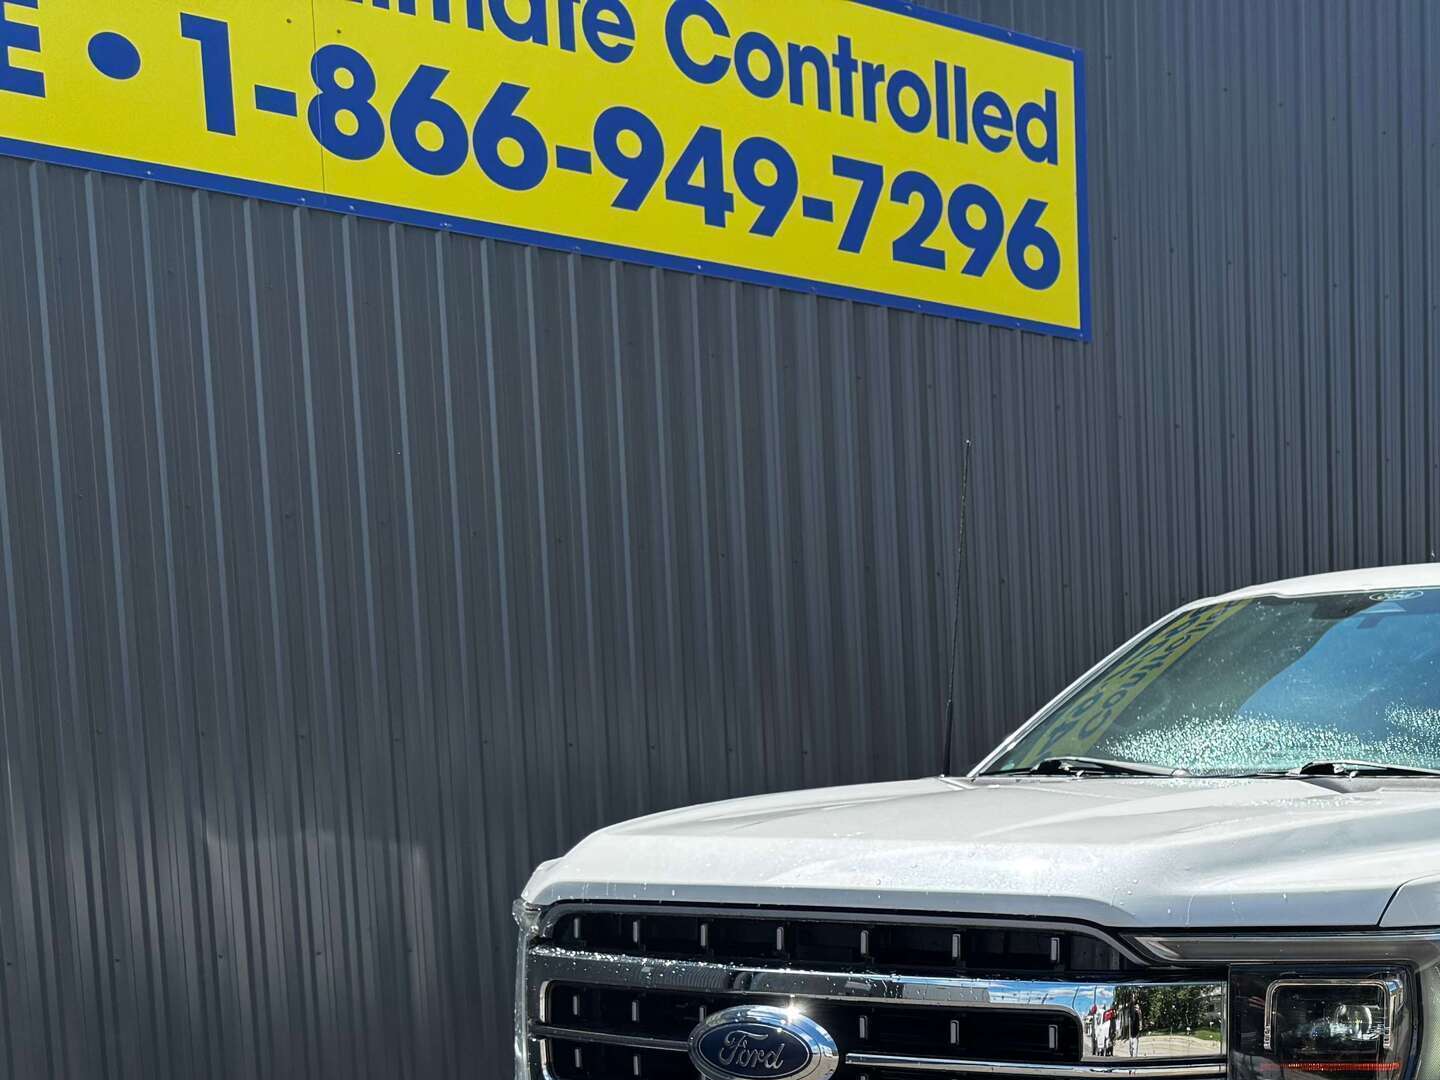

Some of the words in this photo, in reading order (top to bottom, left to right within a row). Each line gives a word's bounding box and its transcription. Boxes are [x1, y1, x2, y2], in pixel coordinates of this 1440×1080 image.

[180, 12, 1062, 291] 1-866-949-7296
[666, 0, 1058, 165] Controlled
[718, 1030, 784, 1070] Ford
